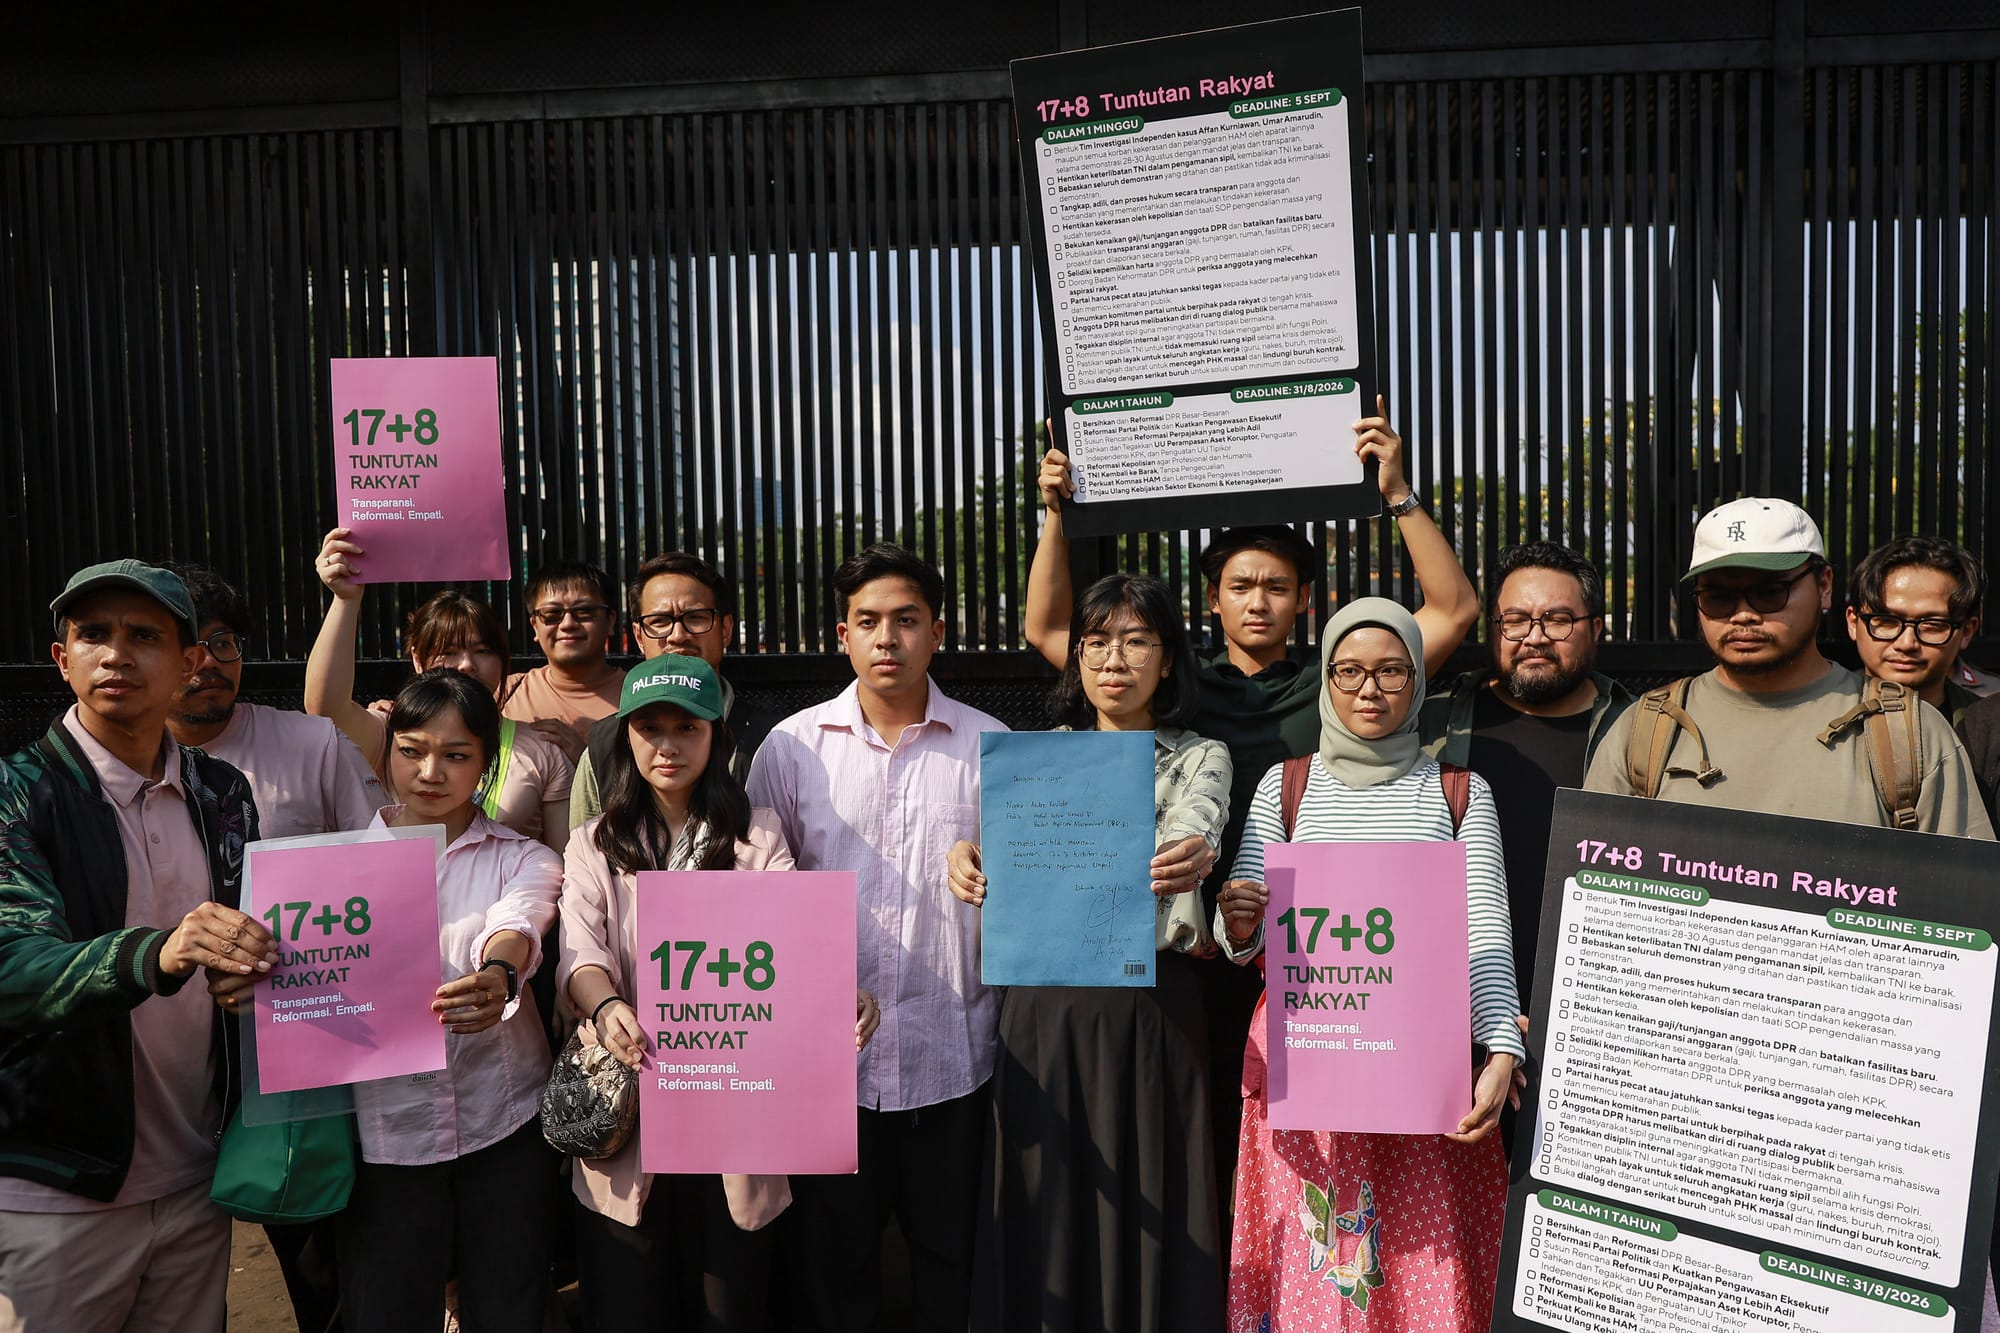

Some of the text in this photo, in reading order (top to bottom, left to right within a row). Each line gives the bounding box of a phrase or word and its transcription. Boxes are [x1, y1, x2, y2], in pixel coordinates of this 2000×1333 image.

[1037, 70, 1274, 122] 17+8 Tuntutan Rakyat
[1234, 91, 1330, 113] DEADLINE: 5 SEPT
[1048, 119, 1138, 140] DALAM 1 MINGGU
[1236, 381, 1343, 399] DEADLINE: 31/8/2026
[1083, 396, 1161, 410] DALAM 1 TAHUN
[343, 408, 439, 446] 17+8
[349, 454, 438, 469] TUNTUTAN
[351, 474, 420, 489] RAKYAT
[351, 498, 415, 509] Transparansi.
[352, 510, 443, 521] Reformasi. Empati.
[631, 674, 702, 694] PALESTINE
[1576, 839, 1897, 907] 17+8 Tuntutan Rakyat
[1582, 873, 1702, 901] DALAM 1 MINGGU
[263, 896, 371, 942] 17+8
[1586, 892, 1959, 961] Bentuk Tim Investigasi Independen kasus Affan Kurniawan, Umar Amarudin,
[1834, 911, 1975, 943] DEADLINE: 5 SEPT
[1277, 907, 1394, 954] 17+8
[651, 941, 775, 991] 17+8
[1582, 925, 1954, 996] Hentikan keterlibatan TNI dalam pengamanan sipil, kembalikan TNI ke barak.
[271, 968, 350, 990] RAKYAT
[1283, 964, 1393, 985] TUNTUTAN
[272, 992, 344, 1010] Transparansi.
[1285, 992, 1370, 1009] RAKYAT
[1578, 957, 1912, 1026] Tangkap, adili, dan proses hukum secara transparan para anggota dan
[272, 1002, 375, 1023] Reformasi. Empati.
[656, 1003, 772, 1022] TUNTUTAN
[1284, 1020, 1362, 1035] Transparansi.
[658, 1031, 748, 1049] RAKYAT
[1285, 1036, 1396, 1052] Reformasi. Empati.
[1573, 1001, 1937, 1081] Bekukan kenaikan gaji/tunjangan anggota DPR dan batalkan fasilitas baru.
[657, 1061, 739, 1076] Transparansi.
[658, 1078, 775, 1093] Reformasi. Empati.
[1568, 1044, 1920, 1127] Dorong Badan Kehormatan DPR untuk periksa anggota yang melecehkan
[1552, 1195, 1661, 1233] DALAM 1 TAHUN
[1554, 1154, 1941, 1258] Ambil langkah darurat untuk mencegah PHK massal dan lindungi buruh kontrak.
[1546, 1217, 1752, 1281] Bersihkan dan Reformasi DPR Besar-Besaran
[1545, 1228, 1829, 1314] Reformasi Partai Politik dan Kuatkan Pengawasan Eksekutif
[1767, 1255, 1929, 1308] DEADLINE: 31/8/2026
